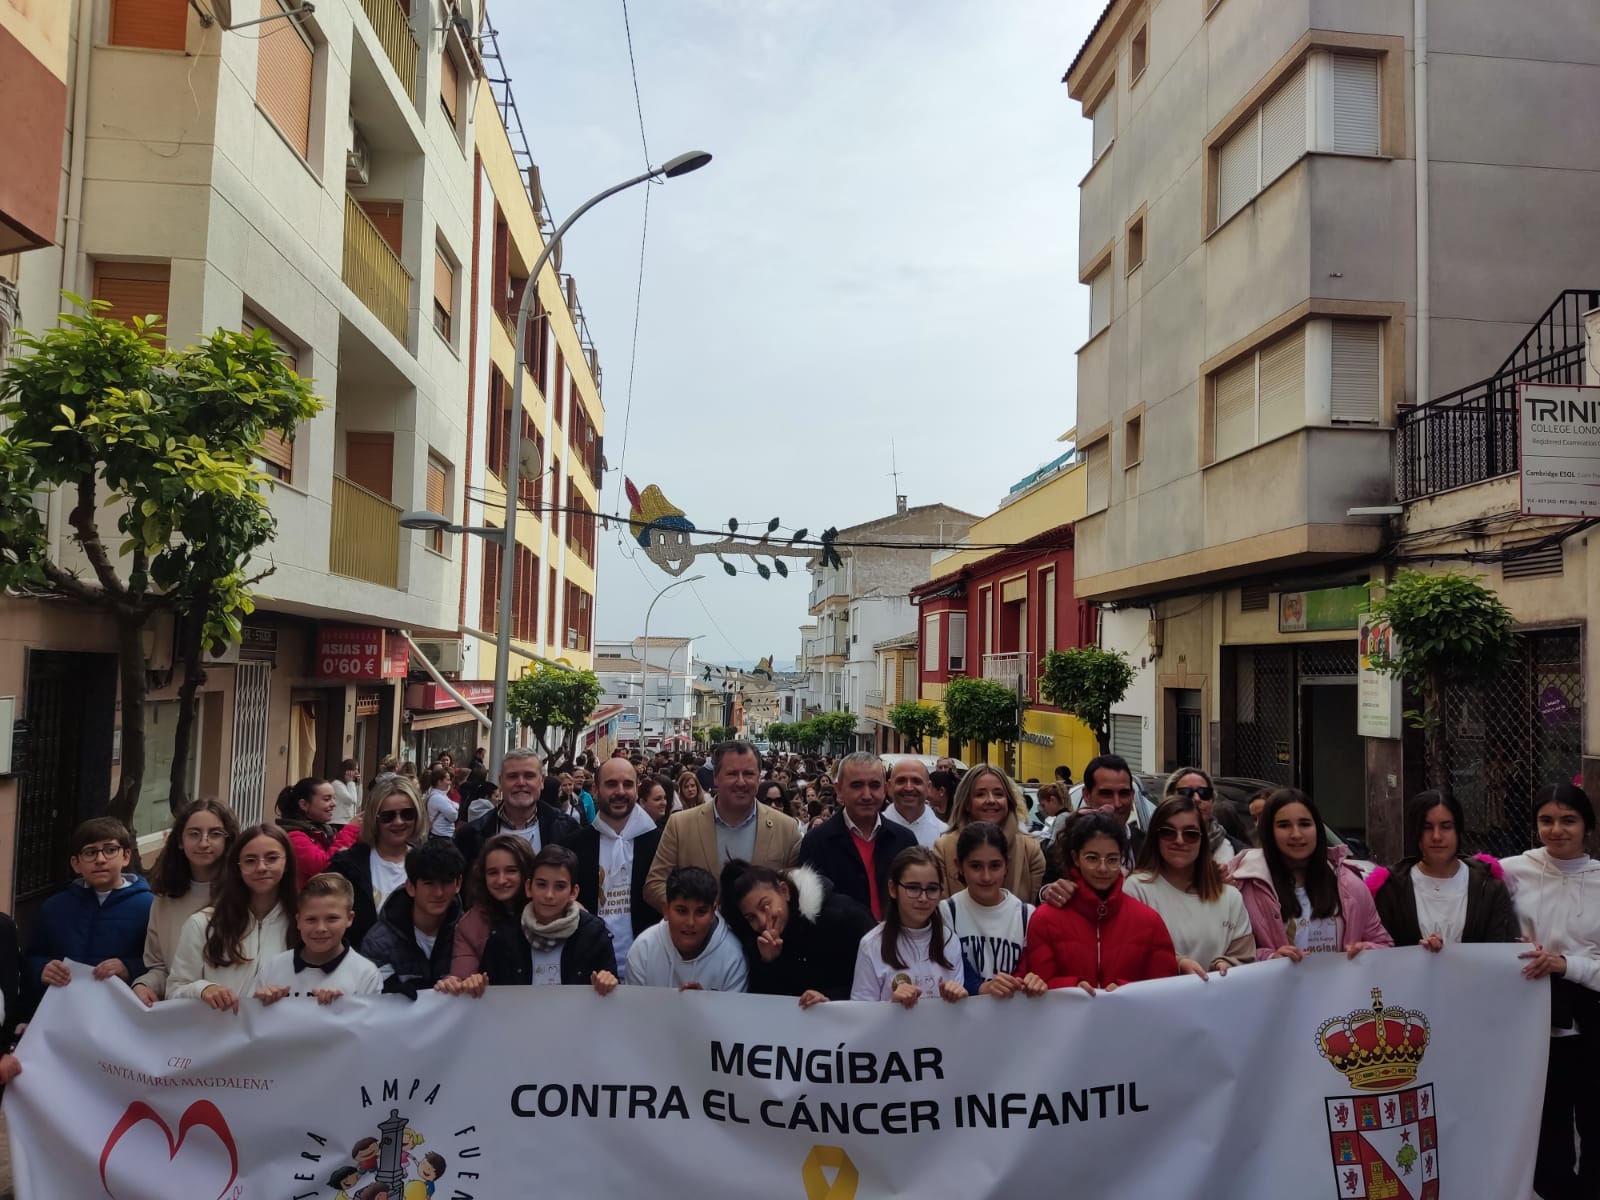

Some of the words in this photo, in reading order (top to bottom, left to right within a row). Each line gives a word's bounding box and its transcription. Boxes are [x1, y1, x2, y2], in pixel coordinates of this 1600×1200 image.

[1525, 398, 1600, 424] TRINI
[1530, 423, 1571, 434] COLLEGE
[1525, 469, 1559, 478] Cambridge
[959, 935, 986, 973] EW
[989, 936, 1022, 976] YOR
[711, 1040, 945, 1085] MENGÍBAR
[360, 1078, 441, 1108] AMPA
[510, 1083, 691, 1120] CONTRA
[702, 1088, 750, 1125] EL
[760, 1094, 941, 1135] CÁNCER
[954, 1081, 1149, 1129] INFANTIL
